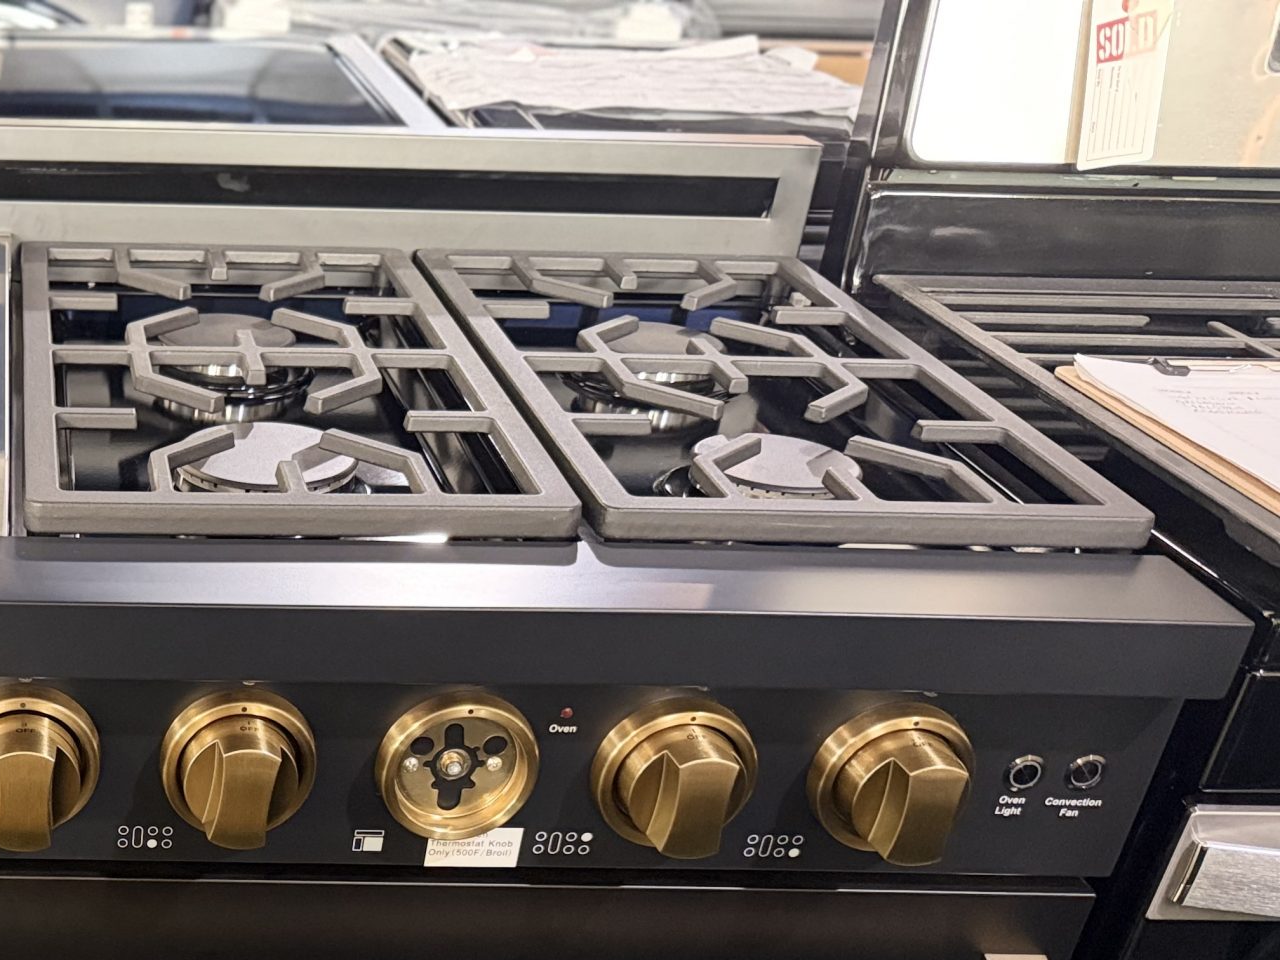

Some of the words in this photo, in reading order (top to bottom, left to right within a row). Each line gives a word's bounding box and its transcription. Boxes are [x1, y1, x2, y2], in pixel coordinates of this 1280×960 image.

[548, 723, 577, 733] Oven
[998, 795, 1026, 805] Oven
[1044, 796, 1103, 807] Convection
[994, 806, 1022, 817] Light
[1058, 808, 1079, 817] Fan
[488, 840, 514, 848] Knob
